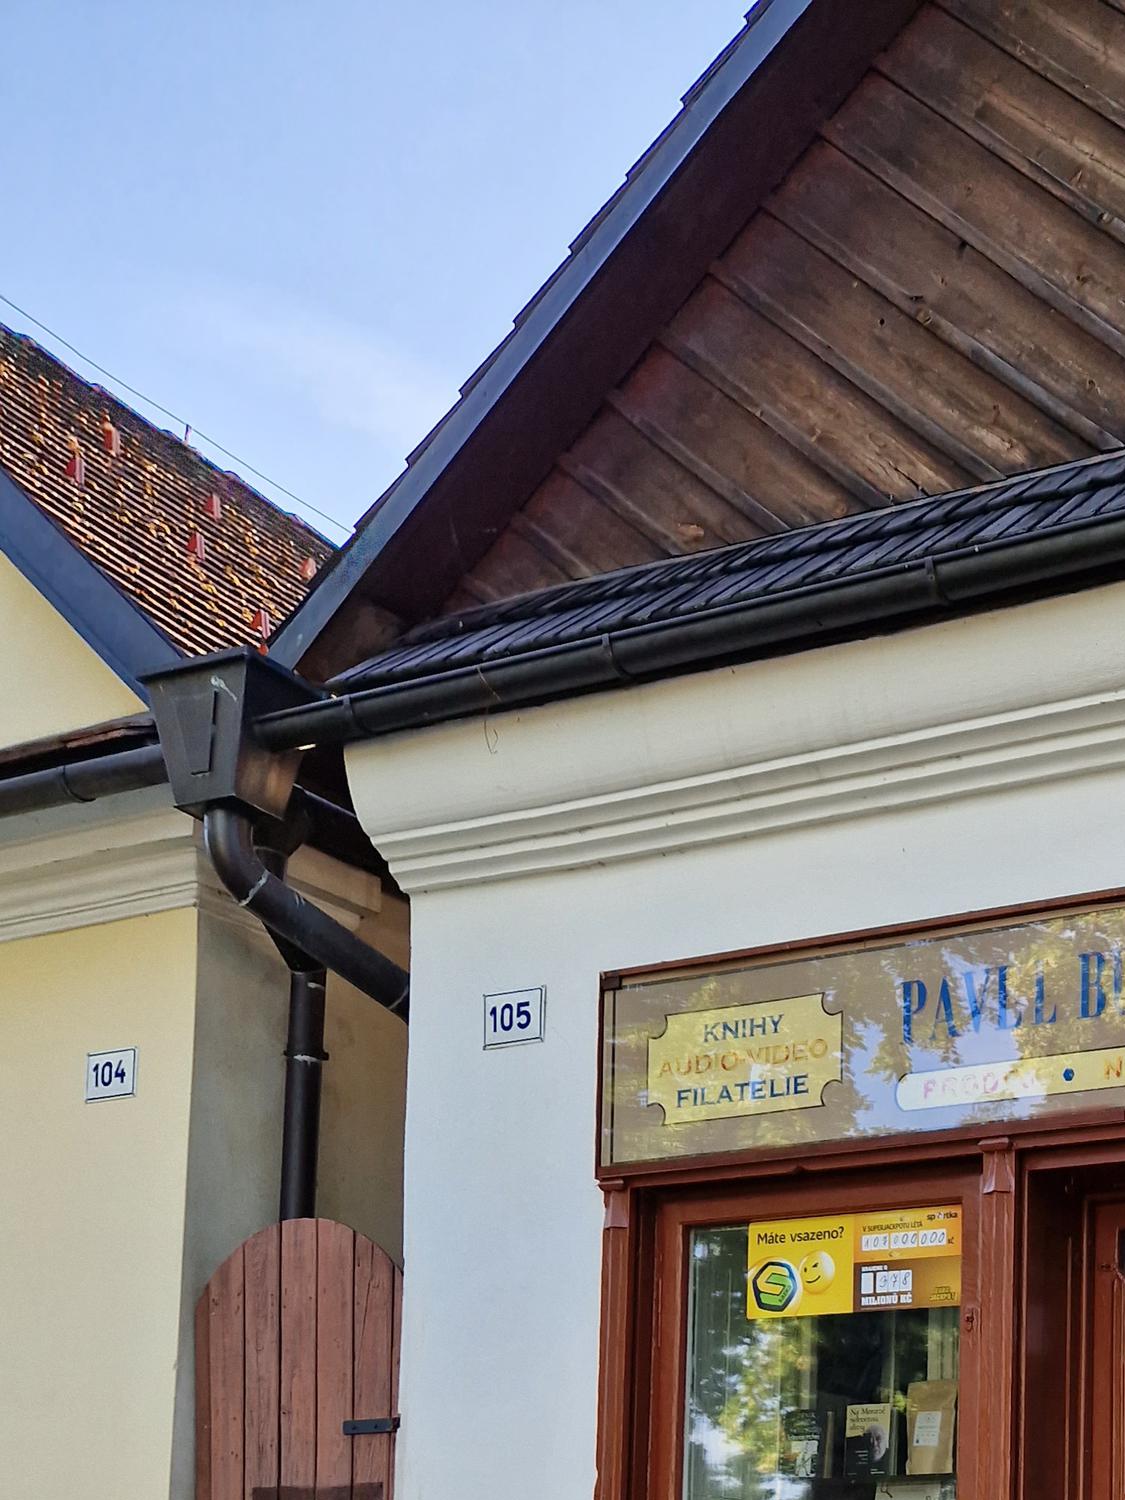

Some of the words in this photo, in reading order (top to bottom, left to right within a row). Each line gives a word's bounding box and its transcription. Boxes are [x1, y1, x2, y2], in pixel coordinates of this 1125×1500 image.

[489, 1000, 532, 1033] 105
[900, 958, 1057, 1044] PAVEL
[702, 1013, 785, 1044] KNIHY
[92, 1059, 127, 1088] 104
[656, 1037, 829, 1079] AUDIO-VIDEO
[675, 1072, 810, 1109] FILATELIE
[757, 1231, 787, 1246] Máte
[789, 1225, 845, 1243] vsazeno?
